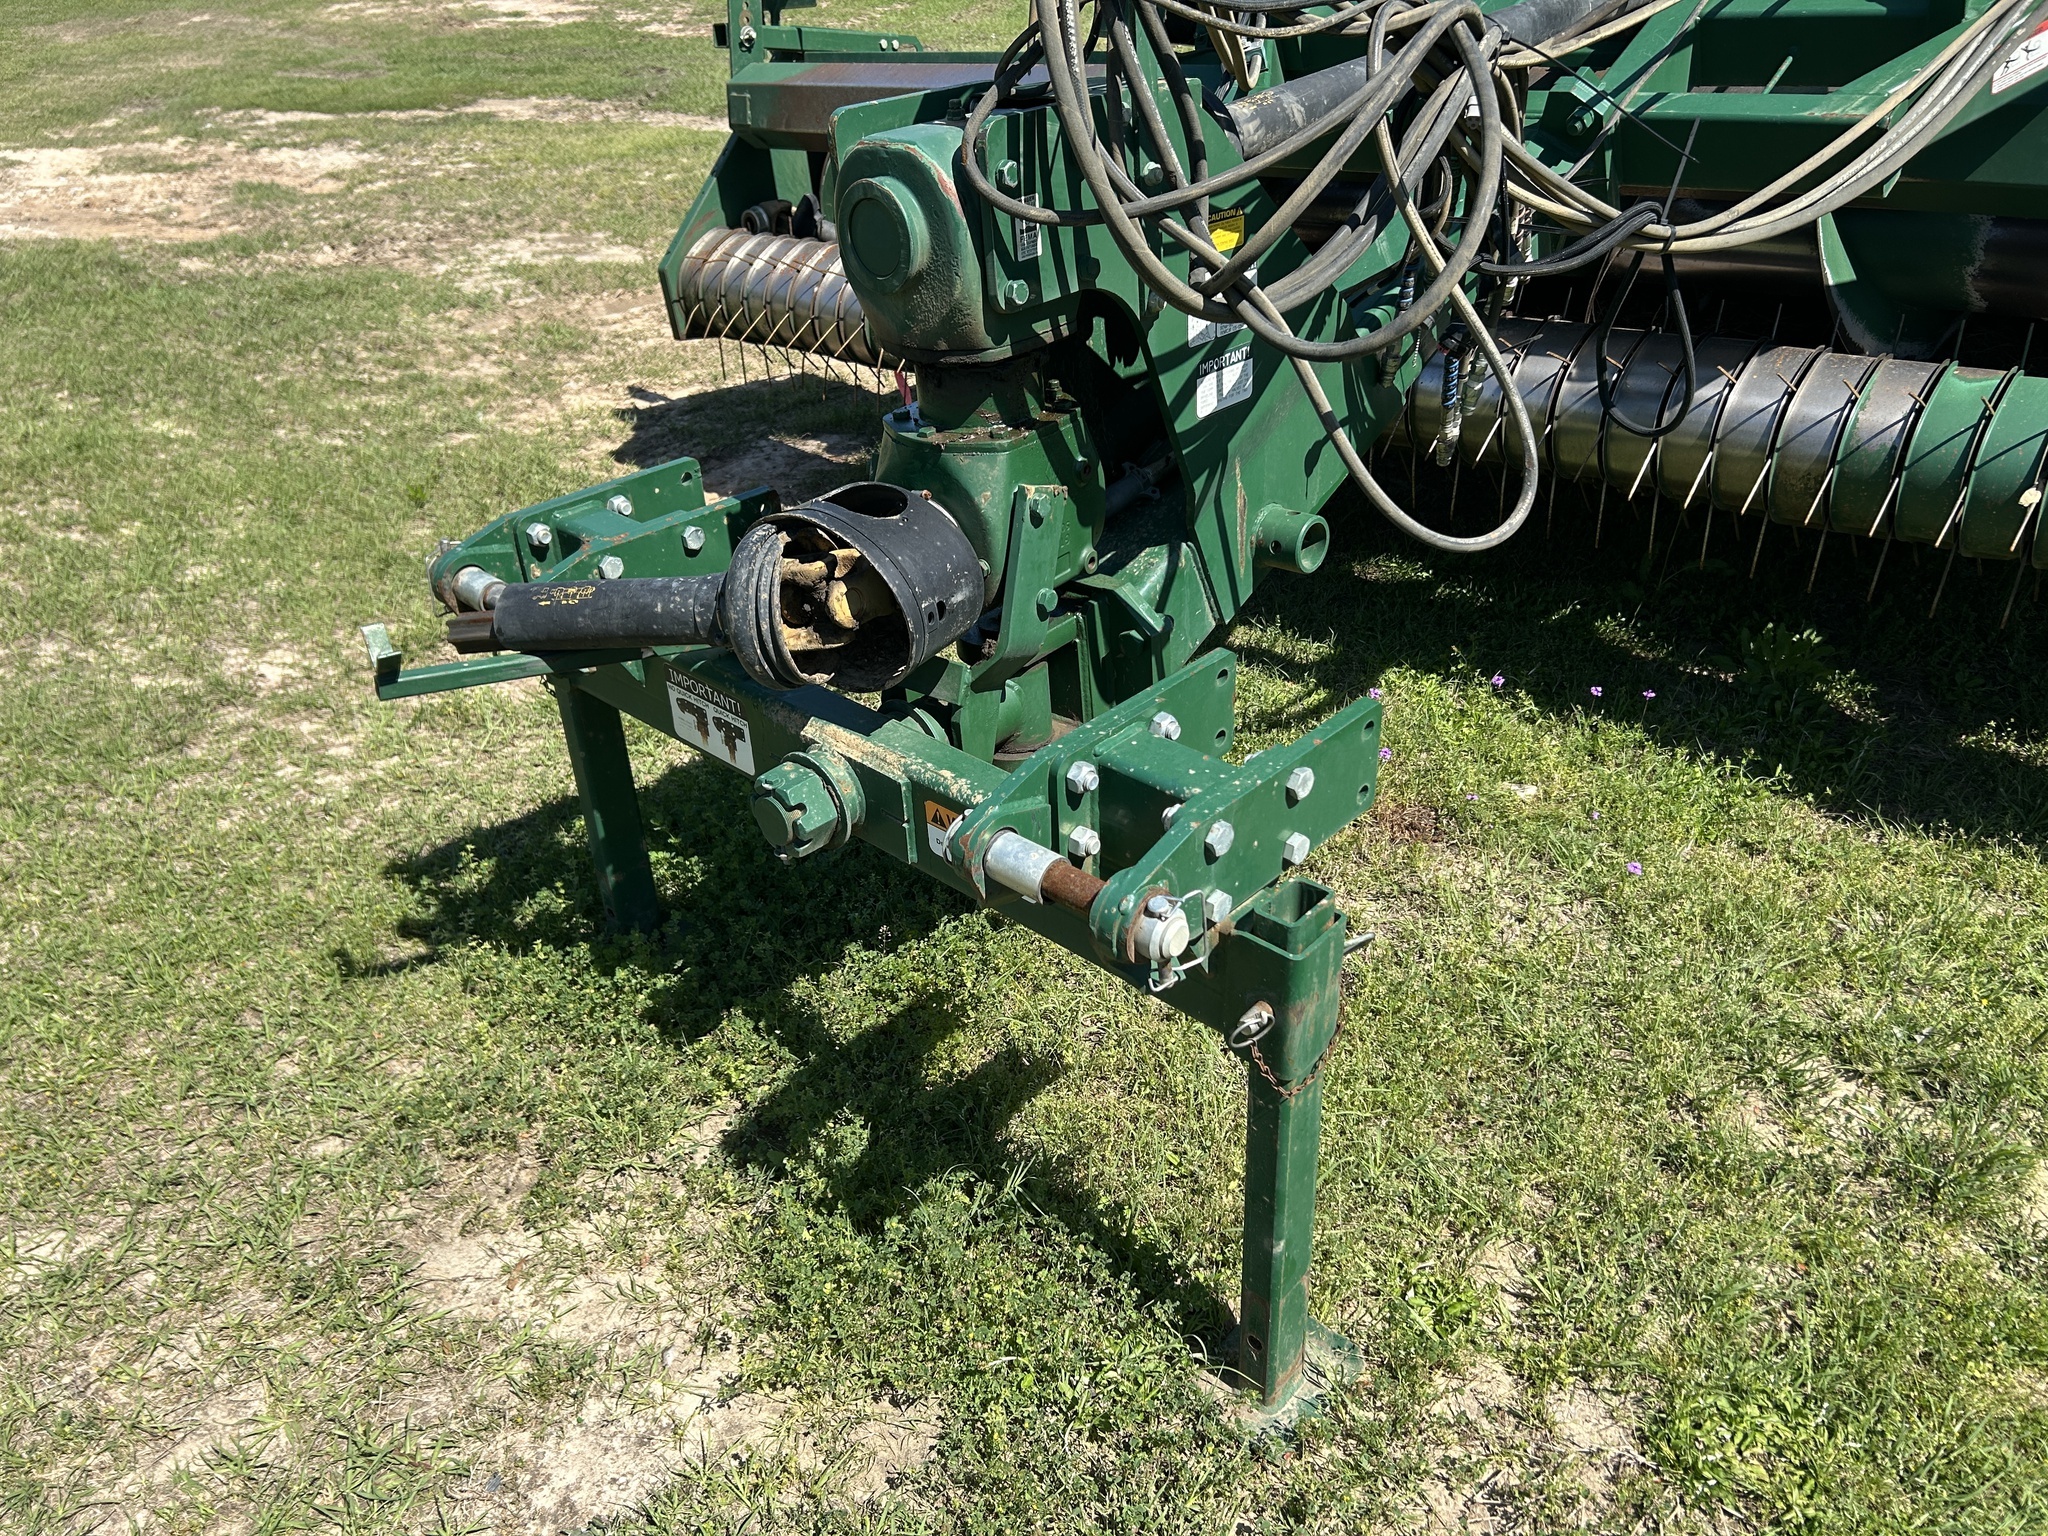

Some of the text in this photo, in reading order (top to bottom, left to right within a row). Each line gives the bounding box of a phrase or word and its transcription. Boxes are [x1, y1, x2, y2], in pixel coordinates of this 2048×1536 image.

[1208, 209, 1236, 222] CAUTION
[1199, 346, 1250, 375] IMPORTANT!
[668, 668, 741, 716] IMPORTANT!
[677, 687, 692, 700] QUICK
[713, 706, 748, 729] QUICK HITCH
